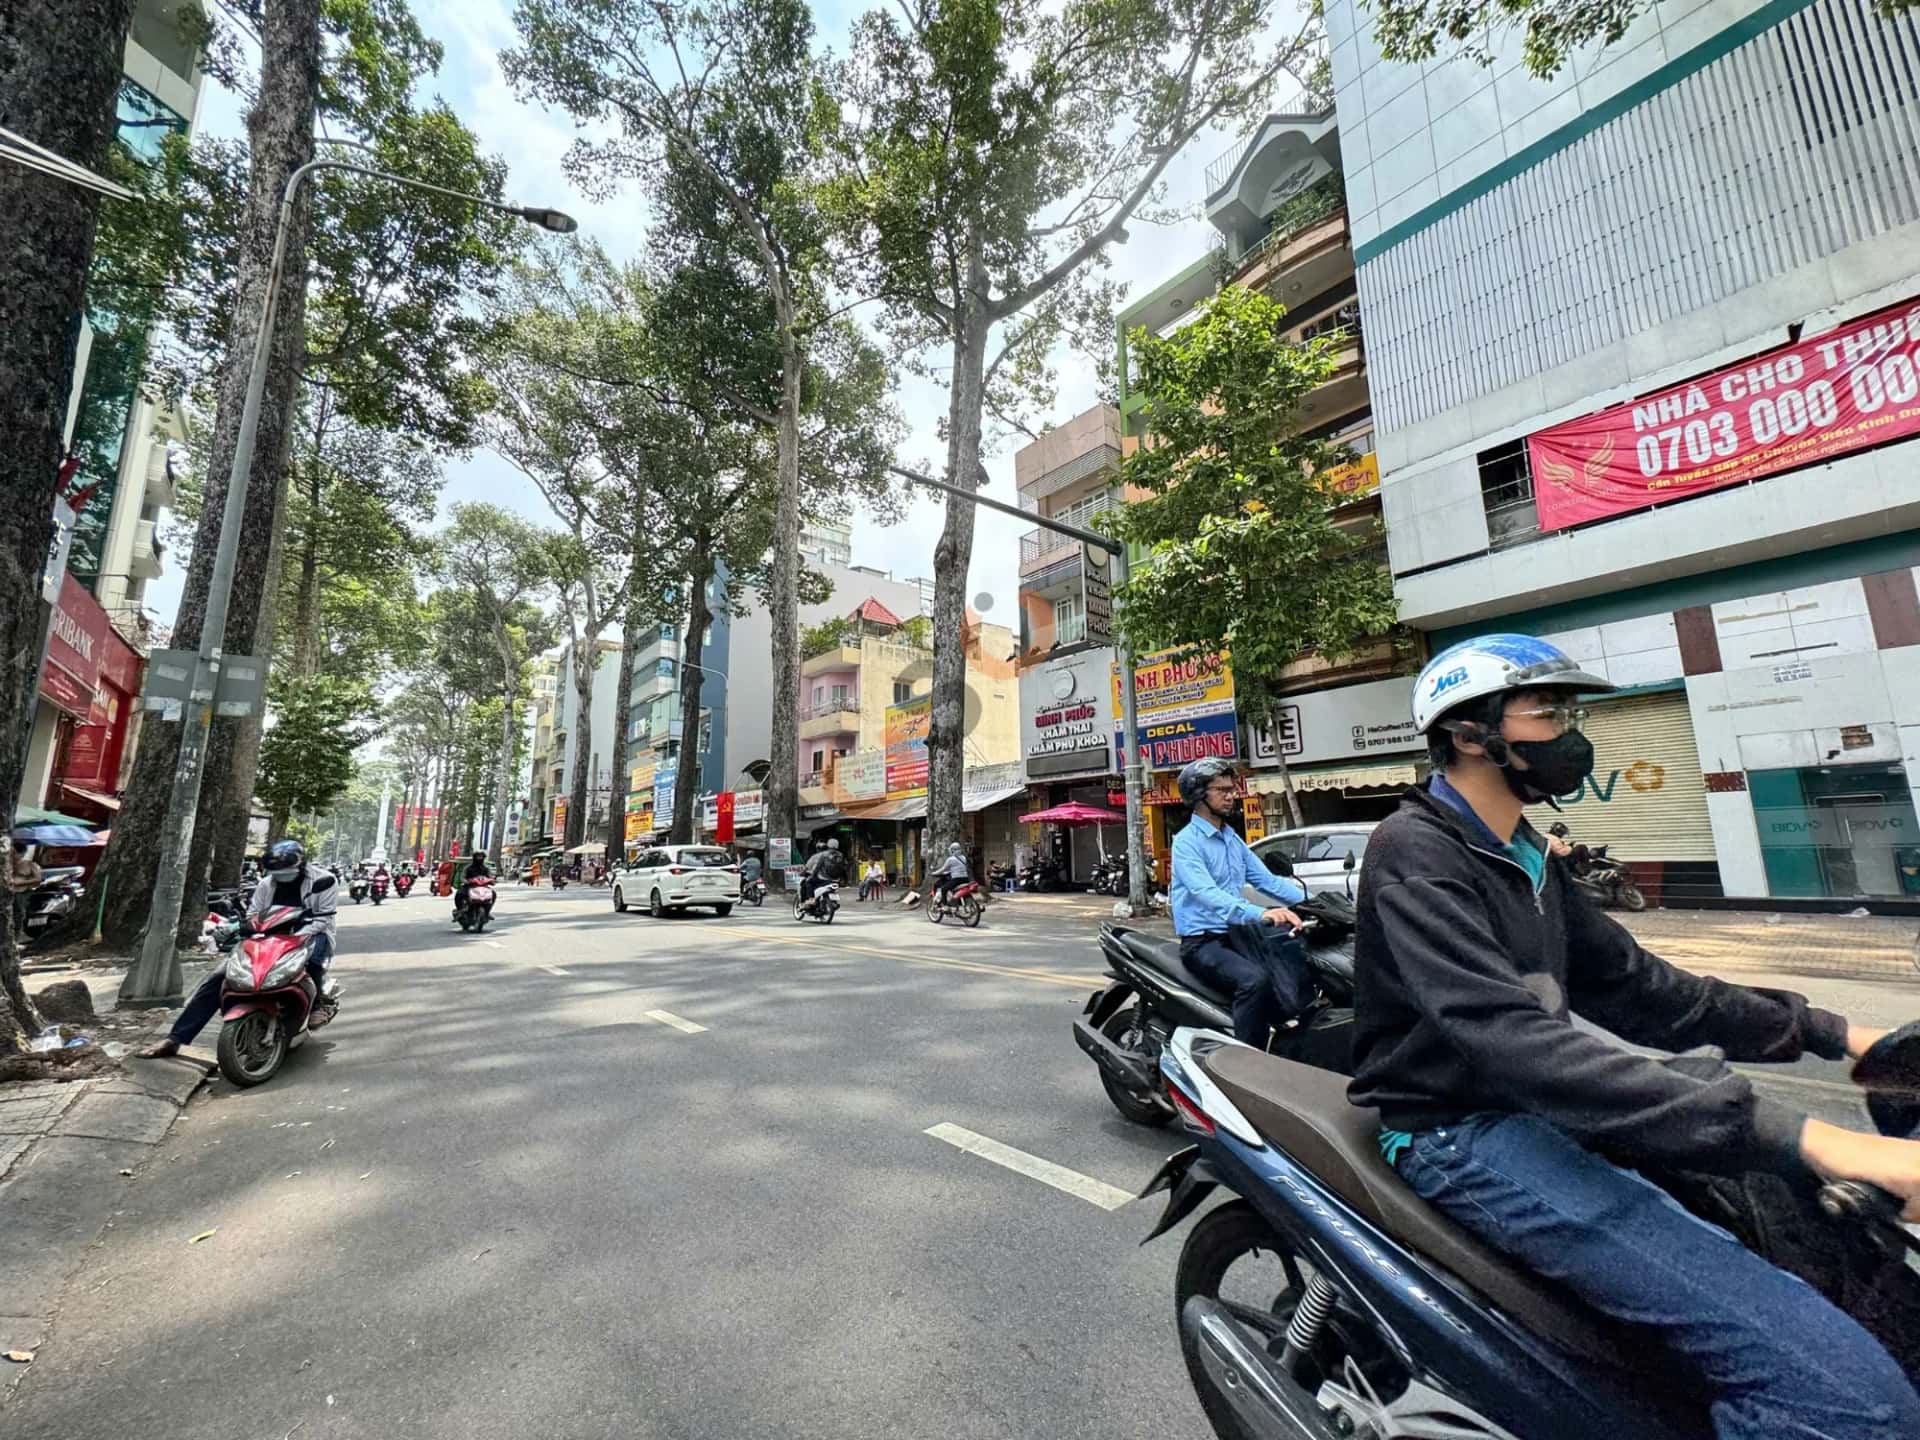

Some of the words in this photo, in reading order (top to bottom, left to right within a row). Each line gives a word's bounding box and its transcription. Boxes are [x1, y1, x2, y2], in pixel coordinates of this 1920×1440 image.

[1632, 384, 1711, 433] NHÀ
[1720, 353, 1804, 402] CHO
[1636, 411, 1739, 478] 0703
[1748, 380, 1839, 444] 000
[1850, 347, 1920, 414] 00
[1857, 414, 1895, 432] Kinh
[1146, 722, 1196, 738] DECAL
[1076, 735, 1108, 749] KHOA
[1316, 777, 1351, 788] COFFEE
